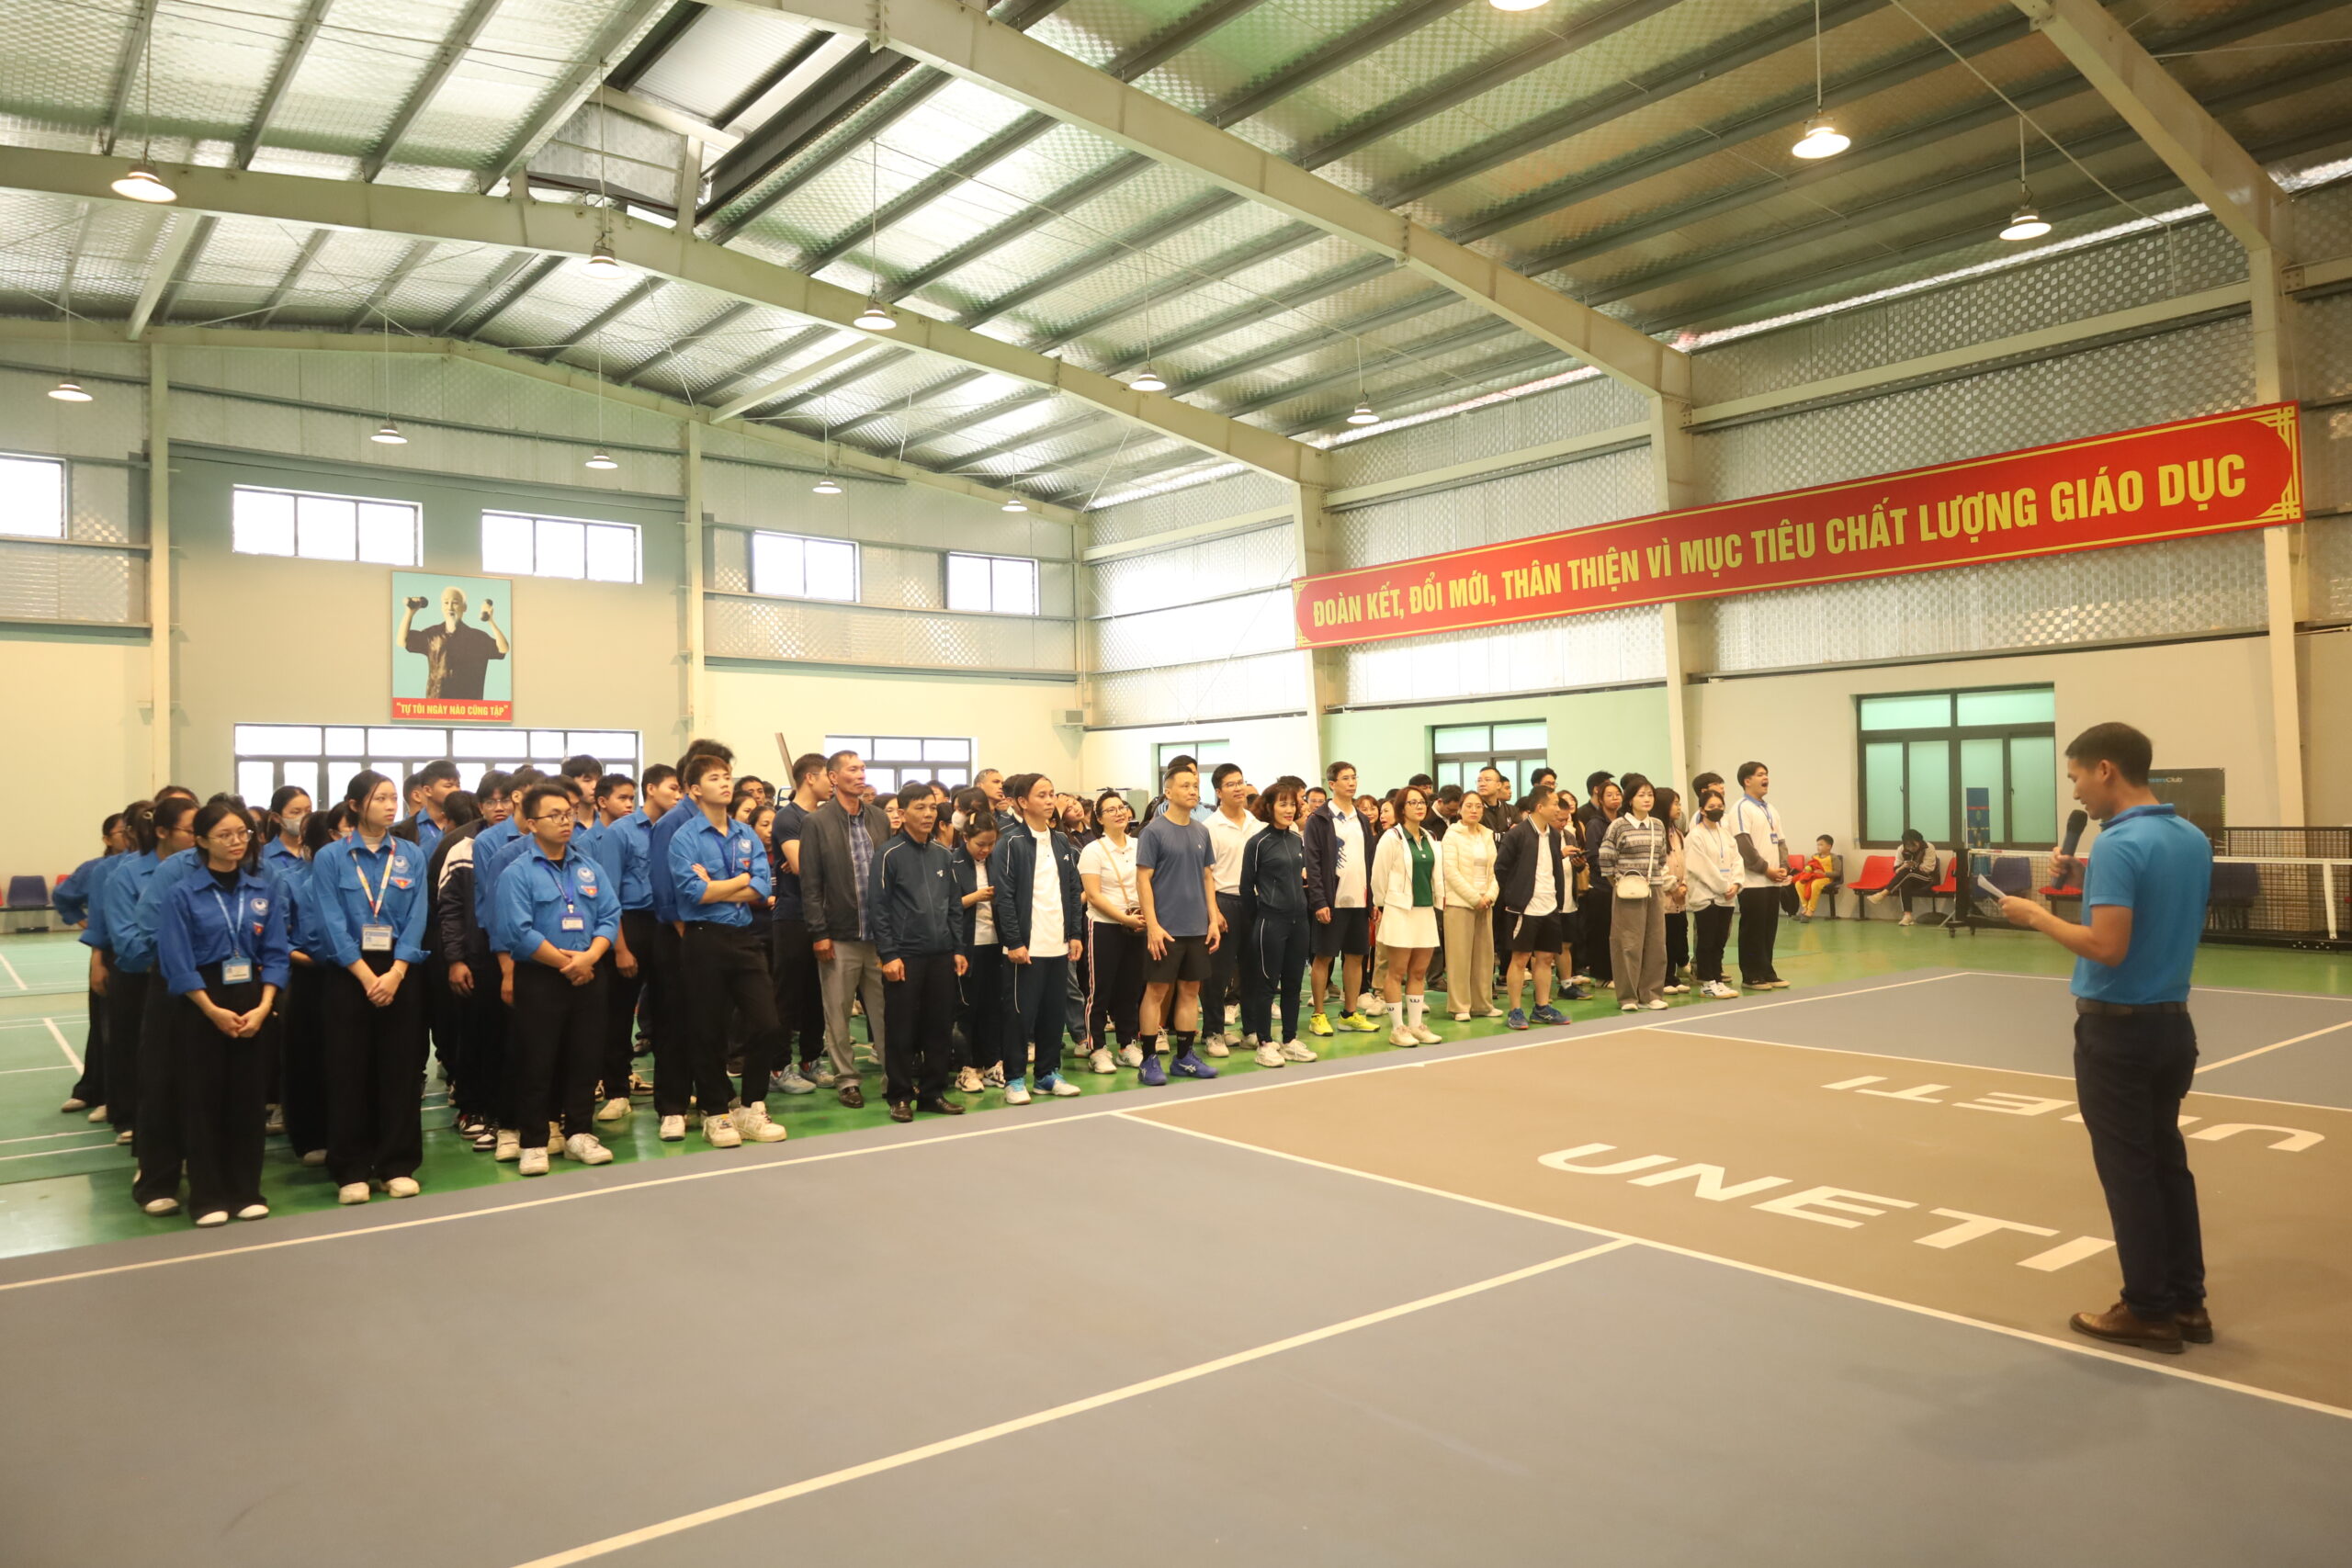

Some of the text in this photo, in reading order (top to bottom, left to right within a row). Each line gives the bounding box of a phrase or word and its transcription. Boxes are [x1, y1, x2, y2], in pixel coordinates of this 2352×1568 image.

[1313, 454, 2246, 627] ĐOÀN KẾT, ĐỔI MỚI, THÂN THIỆN VÌ MỤC TIÊU CHẤT LƯỢNG GIÁO DỤC
[413, 704, 424, 714] TÔI
[426, 704, 448, 715] NGÀY
[449, 705, 466, 716] NÀO
[467, 705, 489, 716] CŨNG
[1537, 1142, 2117, 1272] UNETI
